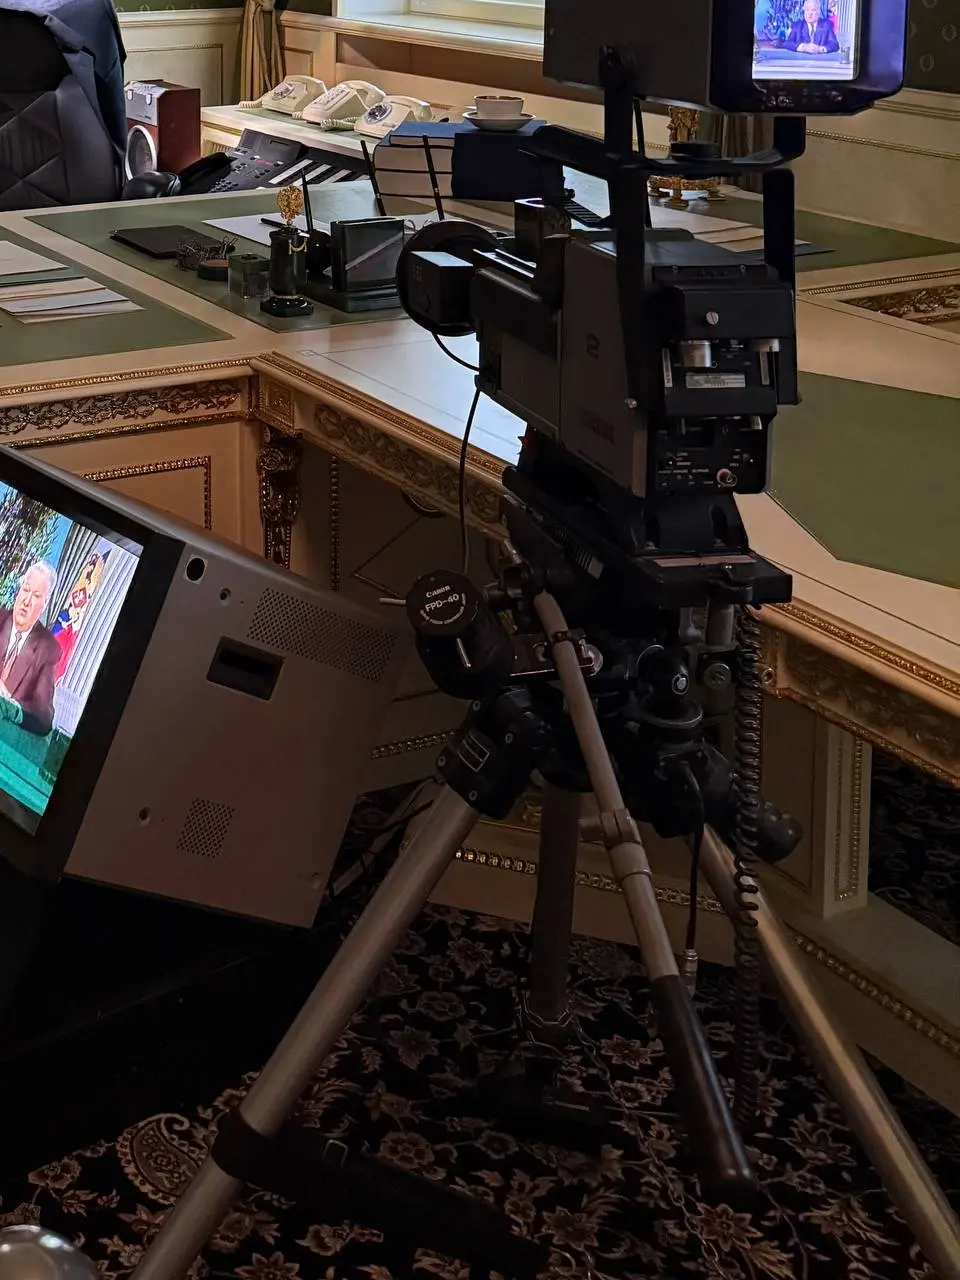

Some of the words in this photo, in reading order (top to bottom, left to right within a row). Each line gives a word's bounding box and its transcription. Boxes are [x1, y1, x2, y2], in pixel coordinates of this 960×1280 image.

[587, 333, 600, 359] 2
[425, 585, 451, 598] Canon
[424, 593, 460, 612] FPD-40
